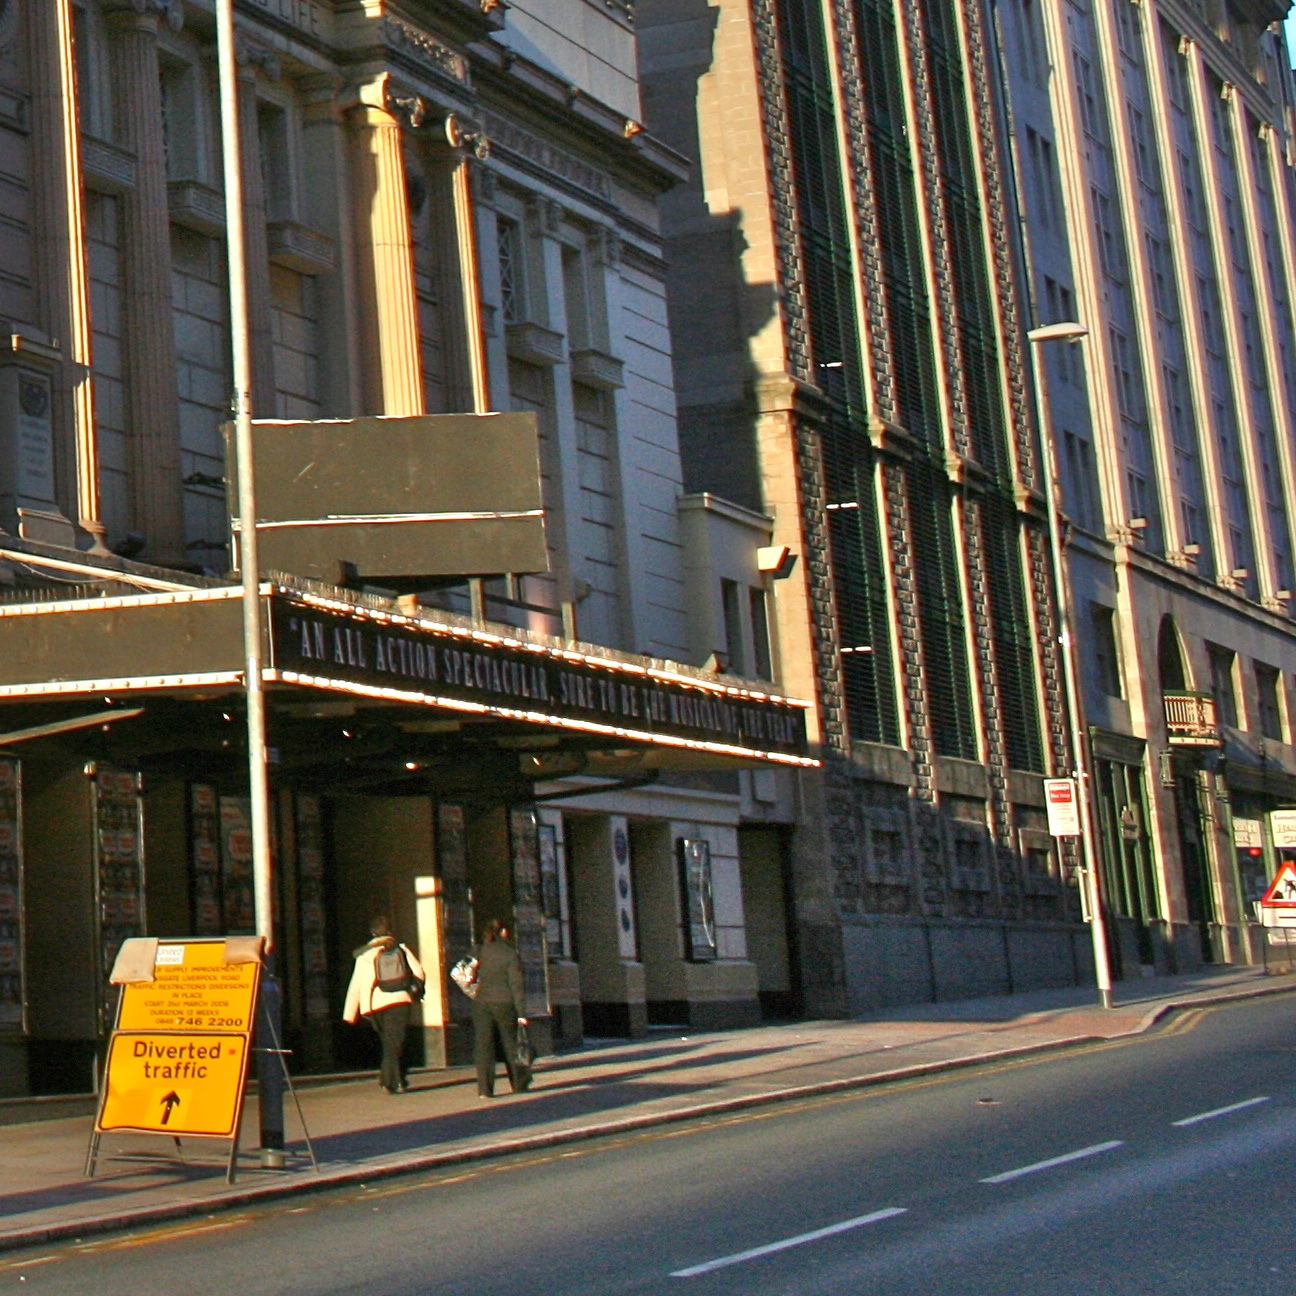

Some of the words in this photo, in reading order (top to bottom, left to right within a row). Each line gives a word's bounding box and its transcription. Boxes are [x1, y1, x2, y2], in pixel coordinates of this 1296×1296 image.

[334, 626, 367, 669] ALL
[375, 633, 438, 681] ACTION
[560, 670, 594, 710] SURE
[191, 964, 244, 973] IMPROVEMENTS
[176, 1017, 203, 1026] 746
[207, 1017, 243, 1027] 2200
[133, 1040, 221, 1060] Diverted
[144, 1061, 208, 1079] traffic
